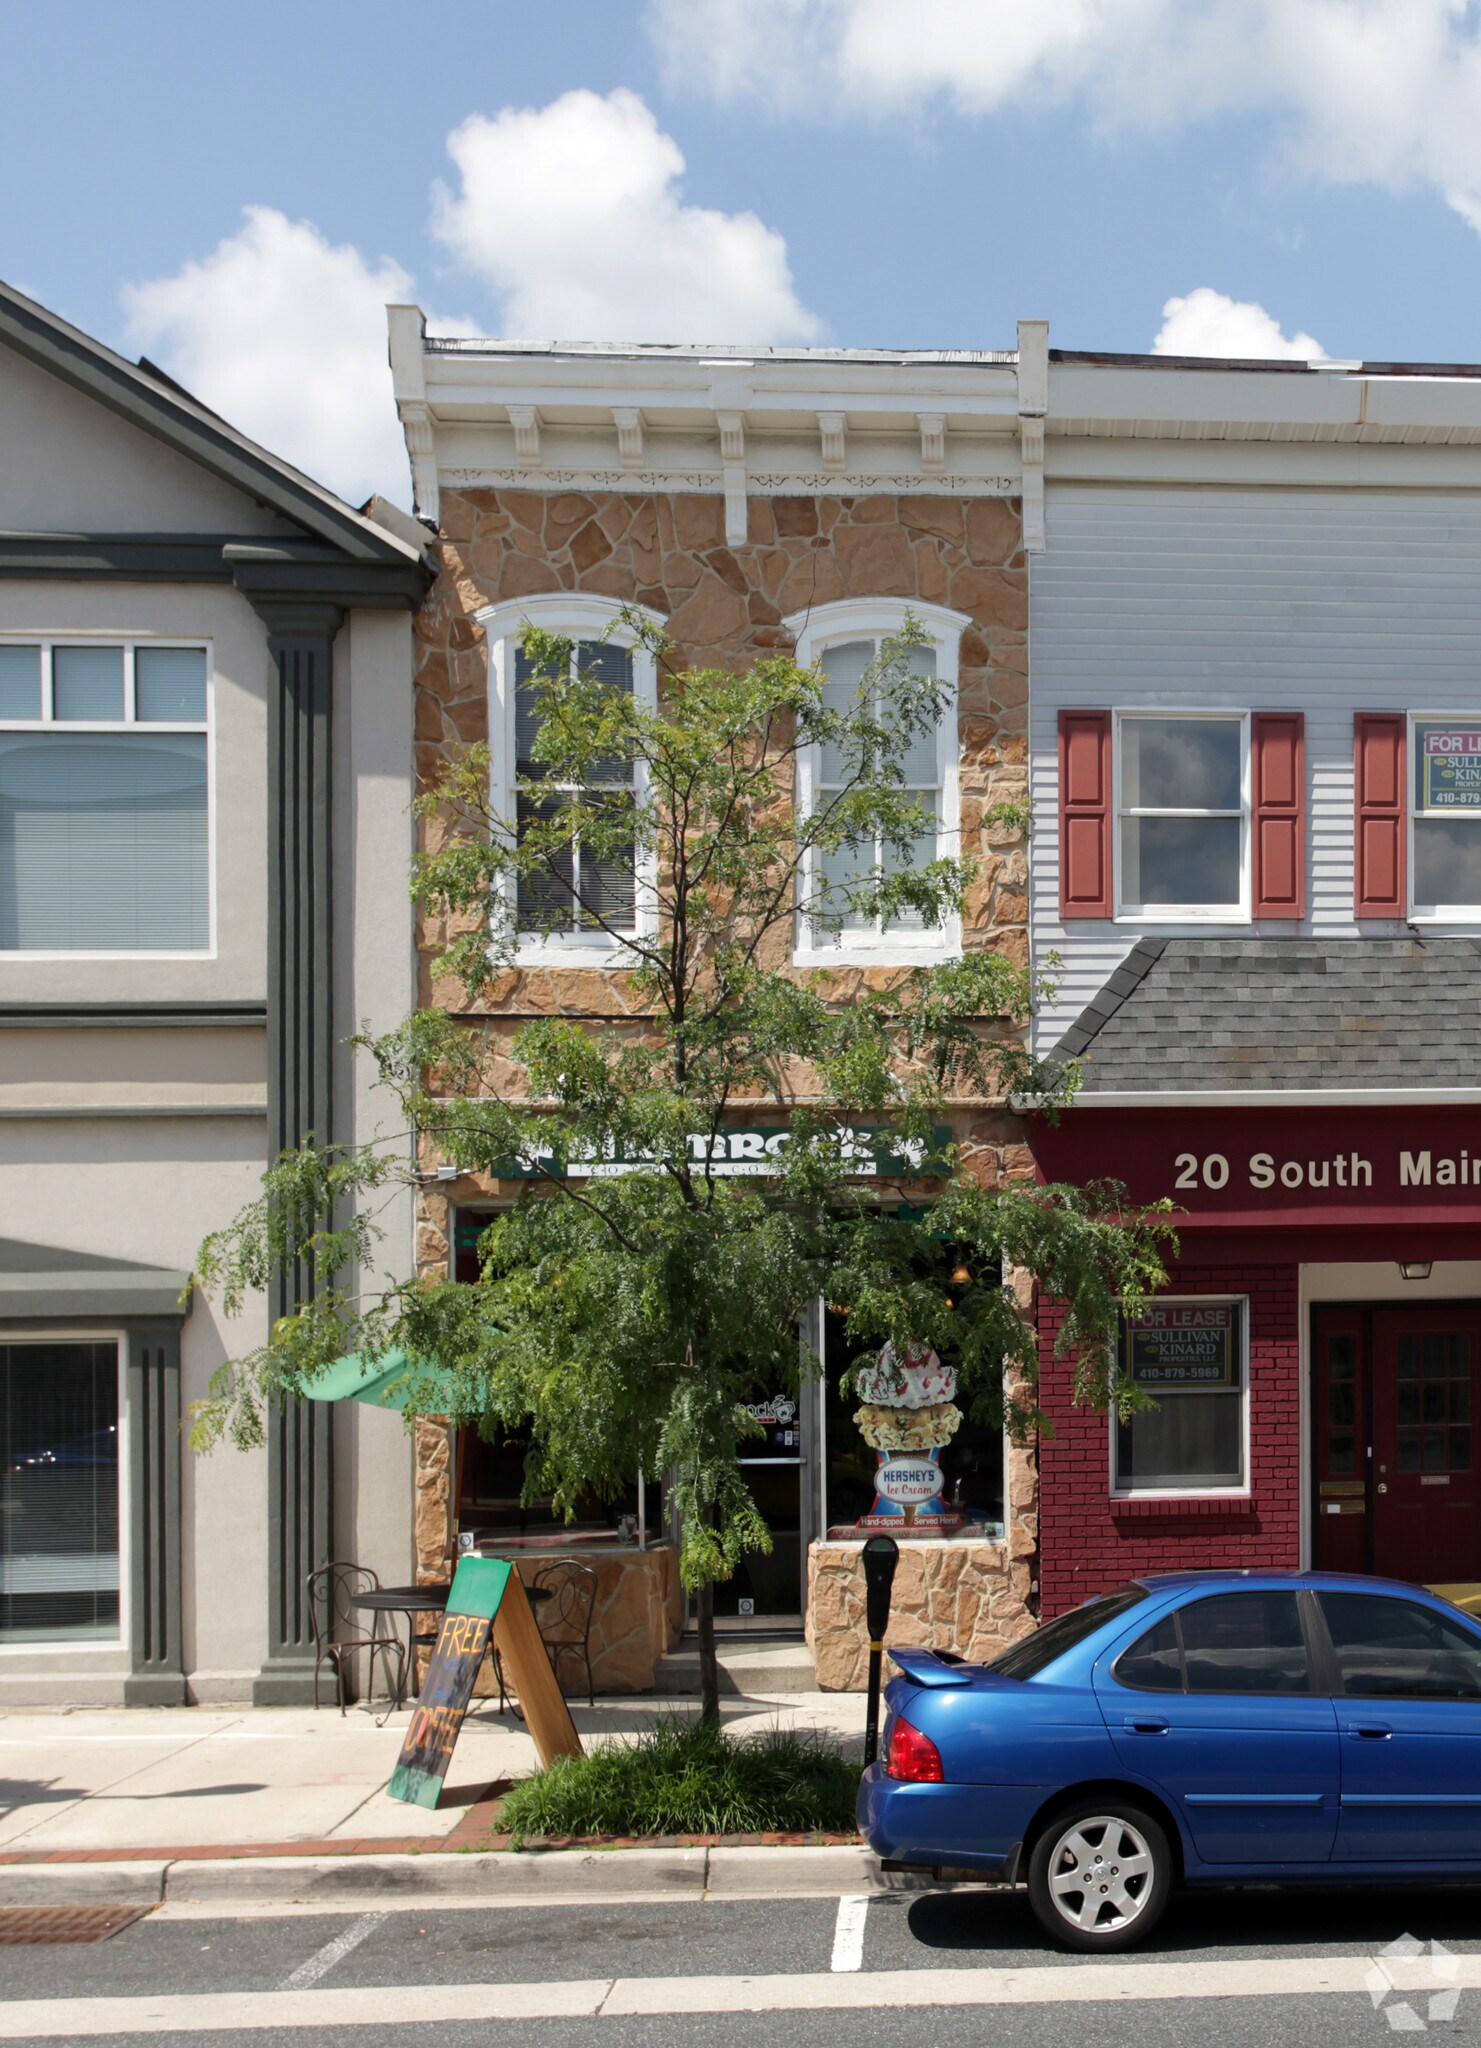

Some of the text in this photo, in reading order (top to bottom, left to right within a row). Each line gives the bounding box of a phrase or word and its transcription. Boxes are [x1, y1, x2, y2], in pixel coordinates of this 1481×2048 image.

[1429, 736, 1463, 752] FOR
[1455, 769, 1481, 780] KIN
[1174, 1153, 1230, 1190] 20
[1248, 1152, 1373, 1188] South
[1172, 1310, 1226, 1326] LEASE
[1150, 1331, 1220, 1343] SULLIVAN
[1159, 1344, 1217, 1355] KINARD
[1139, 1367, 1219, 1378] 410-879-5969
[883, 1470, 935, 1482] HERSHEY'S
[887, 1484, 932, 1494] Ice Cream
[861, 1516, 958, 1526] Hand-dipped Served Here!
[437, 1615, 490, 1657] FREE
